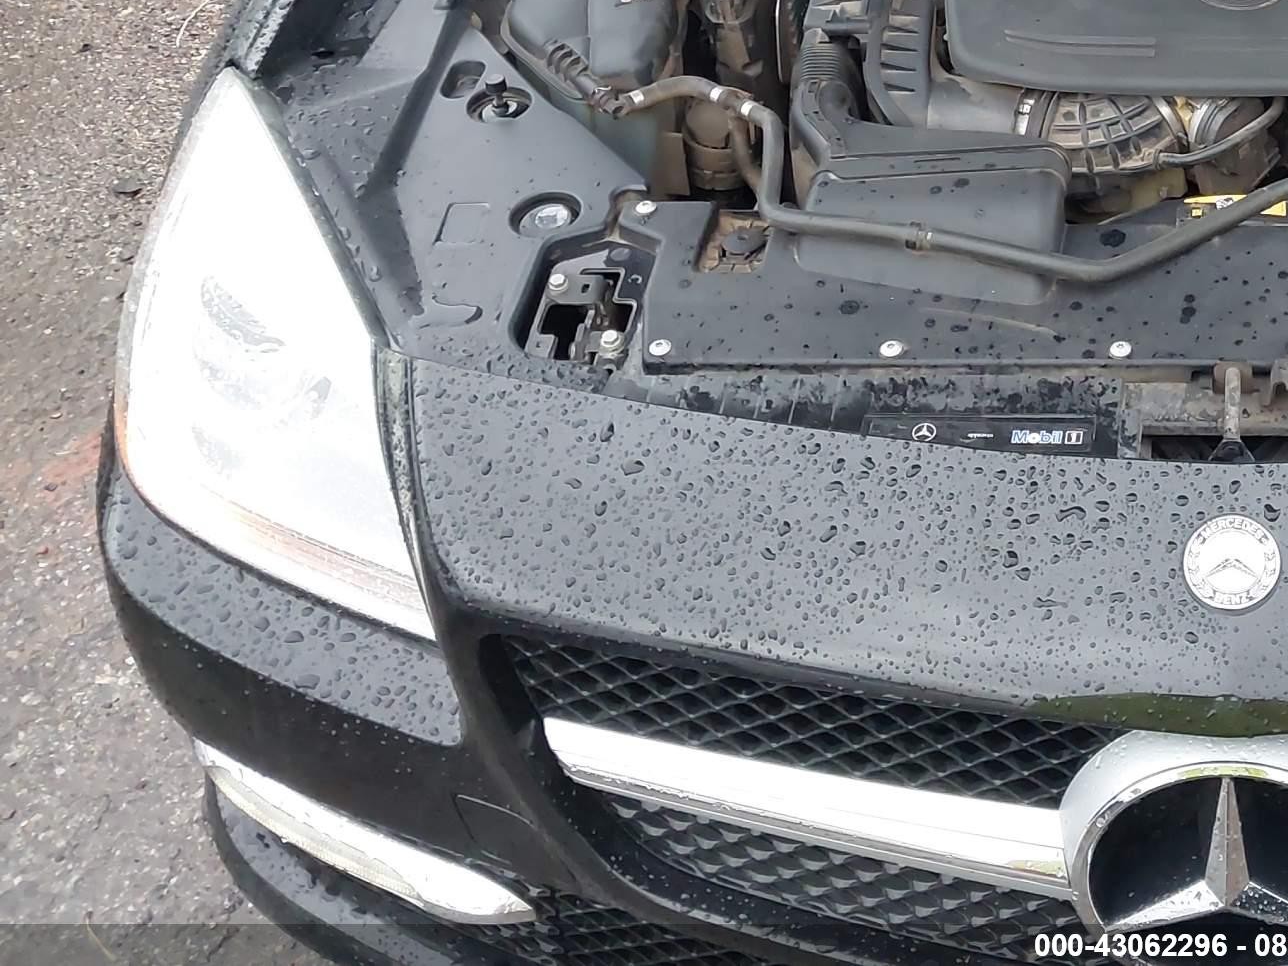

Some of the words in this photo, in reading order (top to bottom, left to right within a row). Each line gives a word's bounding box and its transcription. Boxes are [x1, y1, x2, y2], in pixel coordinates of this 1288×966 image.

[1010, 430, 1063, 444] Mobil
[1200, 518, 1264, 539] MERCEDES
[1214, 591, 1249, 605] BENZ
